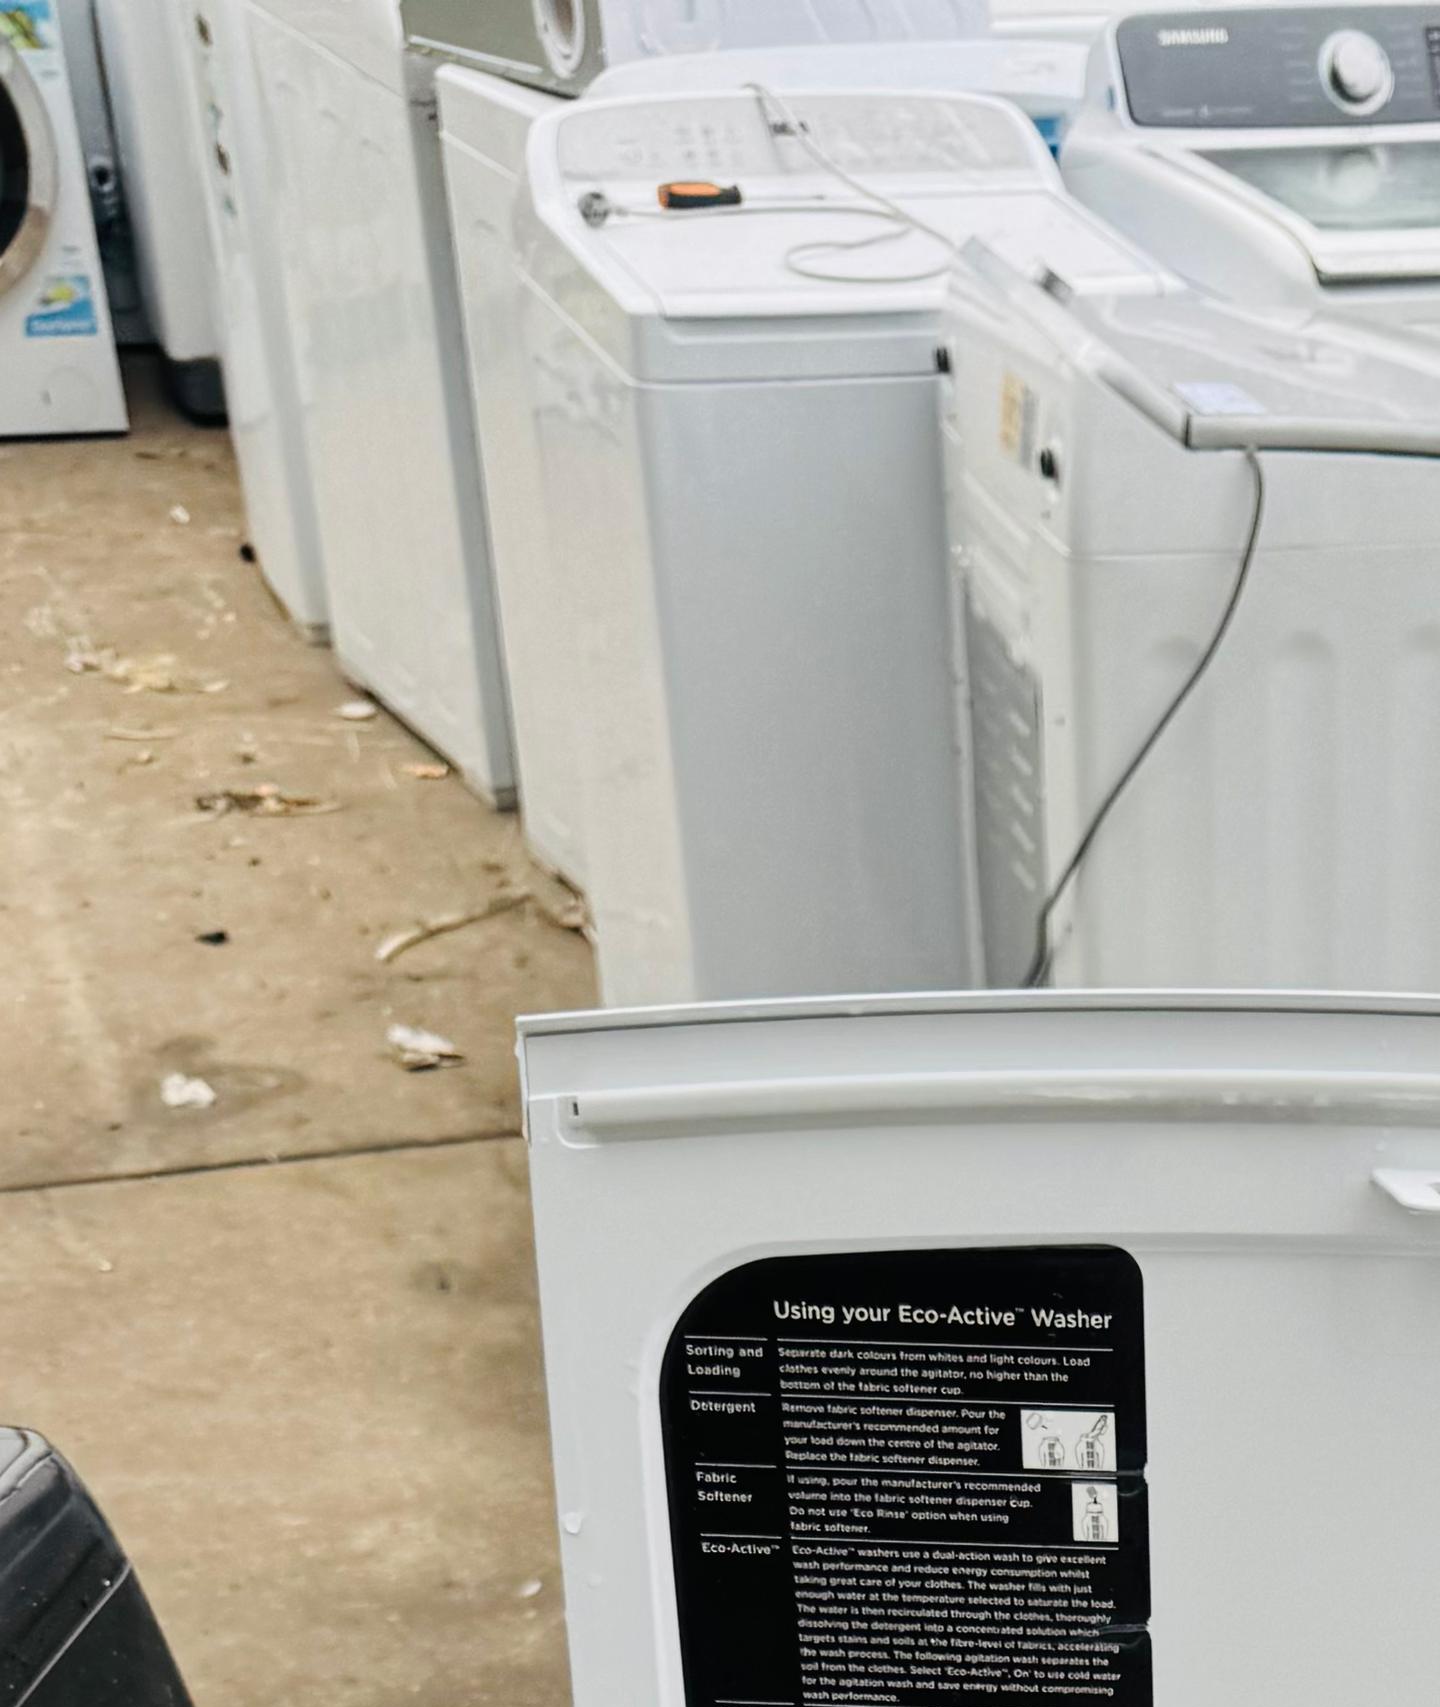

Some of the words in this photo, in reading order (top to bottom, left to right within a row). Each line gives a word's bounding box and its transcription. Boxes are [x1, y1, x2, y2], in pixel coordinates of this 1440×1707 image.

[773, 1300, 836, 1324] Using
[841, 1306, 892, 1324] your
[1030, 1307, 1113, 1329] Washer
[685, 1344, 735, 1358] Sorting
[738, 1347, 764, 1357] and
[829, 1349, 855, 1358] dark
[856, 1350, 897, 1360] colours
[899, 1350, 926, 1360] from
[927, 1352, 965, 1362] whites
[966, 1353, 988, 1363] and
[989, 1353, 1015, 1365] light
[1062, 1356, 1091, 1366] Load
[687, 1363, 741, 1377] Loading
[820, 1366, 857, 1376] evenly
[859, 1367, 899, 1376] around
[900, 1367, 919, 1377] the
[969, 1371, 984, 1379] no
[985, 1369, 1021, 1381] higher
[1023, 1371, 1049, 1381] than
[1050, 1372, 1069, 1382] the
[690, 1399, 756, 1413] Detergent
[826, 1403, 858, 1414] fabric
[859, 1405, 904, 1415] softener
[960, 1408, 986, 1418] Pour
[988, 1409, 1006, 1419] the
[867, 1437, 886, 1447] the
[887, 1439, 922, 1448] centre
[923, 1439, 935, 1448] of
[936, 1439, 955, 1449] the
[695, 1471, 737, 1483] Fabric
[832, 1477, 858, 1486] pour
[860, 1477, 879, 1486] the
[963, 1482, 1042, 1492] recommended
[697, 1490, 753, 1501] Softener
[788, 1505, 806, 1515] Do
[807, 1507, 826, 1516] not
[910, 1511, 947, 1520] option
[948, 1511, 978, 1521] when
[980, 1514, 1010, 1523] using
[856, 1547, 900, 1557] washers
[931, 1550, 991, 1560] dual-action
[992, 1552, 1020, 1561] wash
[1021, 1553, 1034, 1562] to
[1035, 1554, 1058, 1564] give
[1059, 1555, 1107, 1564] excellent
[792, 1560, 821, 1569] wash
[821, 1561, 889, 1572] performance
[890, 1563, 912, 1572] and
[913, 1564, 950, 1574] reduce
[951, 1566, 988, 1577] energy
[989, 1568, 1058, 1577] consumption
[1059, 1569, 1090, 1578] whilst
